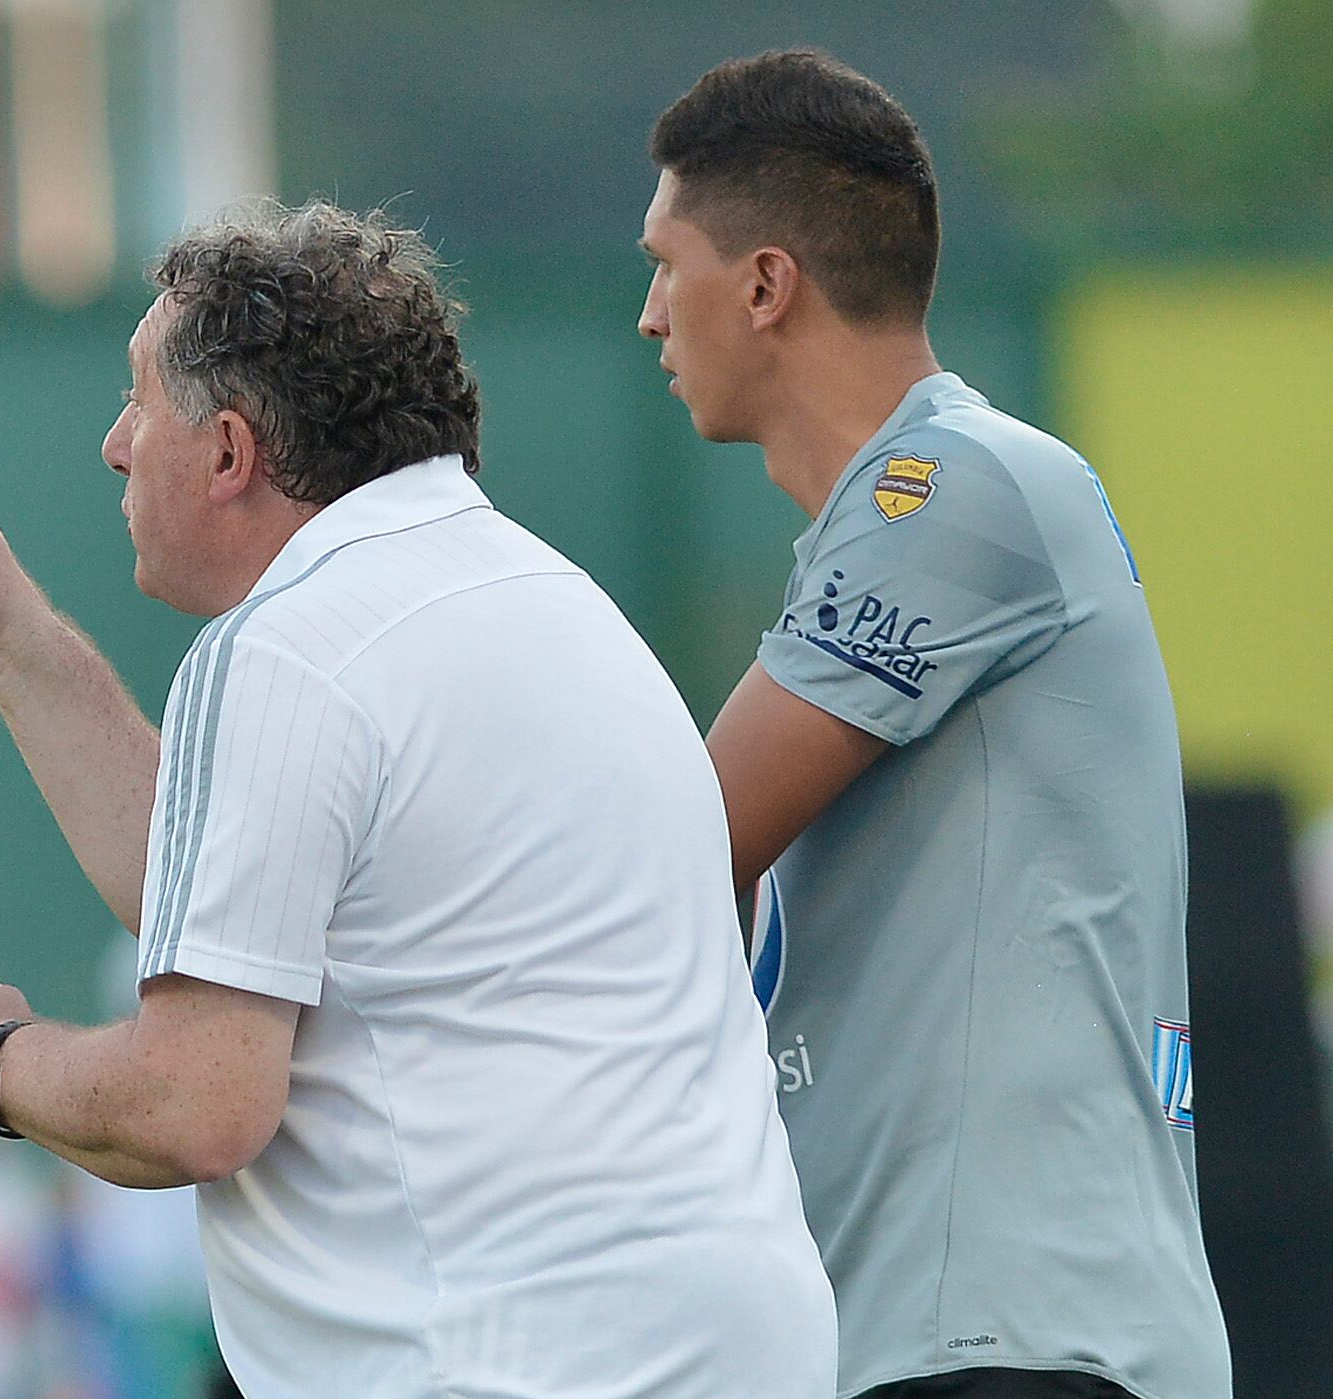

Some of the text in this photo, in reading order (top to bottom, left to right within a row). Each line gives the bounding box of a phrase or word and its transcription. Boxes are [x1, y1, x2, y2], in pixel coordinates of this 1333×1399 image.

[847, 595, 932, 650] PAC
[774, 1034, 814, 1093] si
[947, 1334, 998, 1349] climalite
